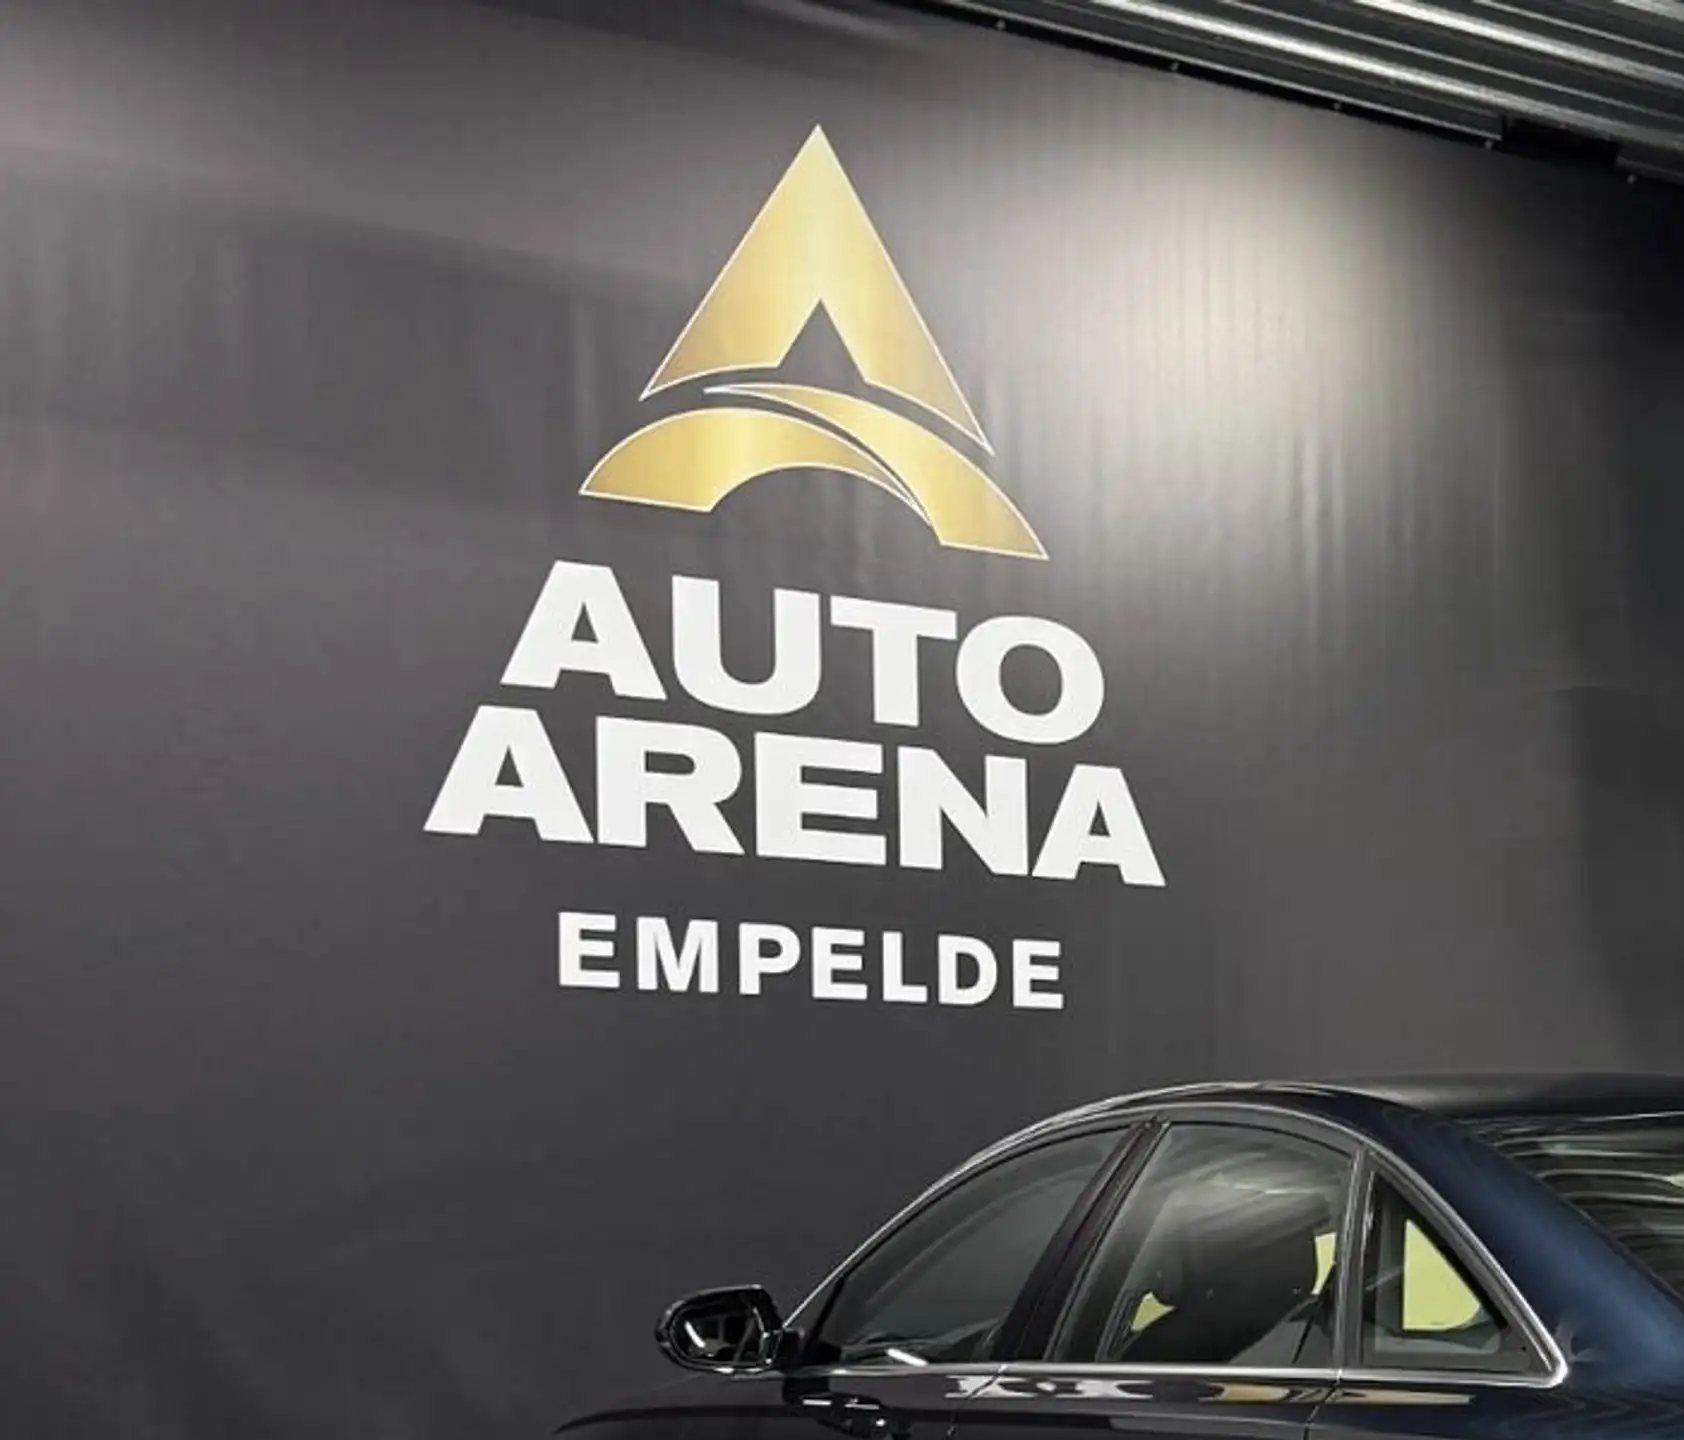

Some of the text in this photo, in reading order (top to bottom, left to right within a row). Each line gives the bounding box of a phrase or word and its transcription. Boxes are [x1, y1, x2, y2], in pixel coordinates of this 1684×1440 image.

[501, 560, 1104, 743] AUTO
[424, 705, 1165, 886] ARENA
[559, 911, 1063, 1009] EMPELDE
